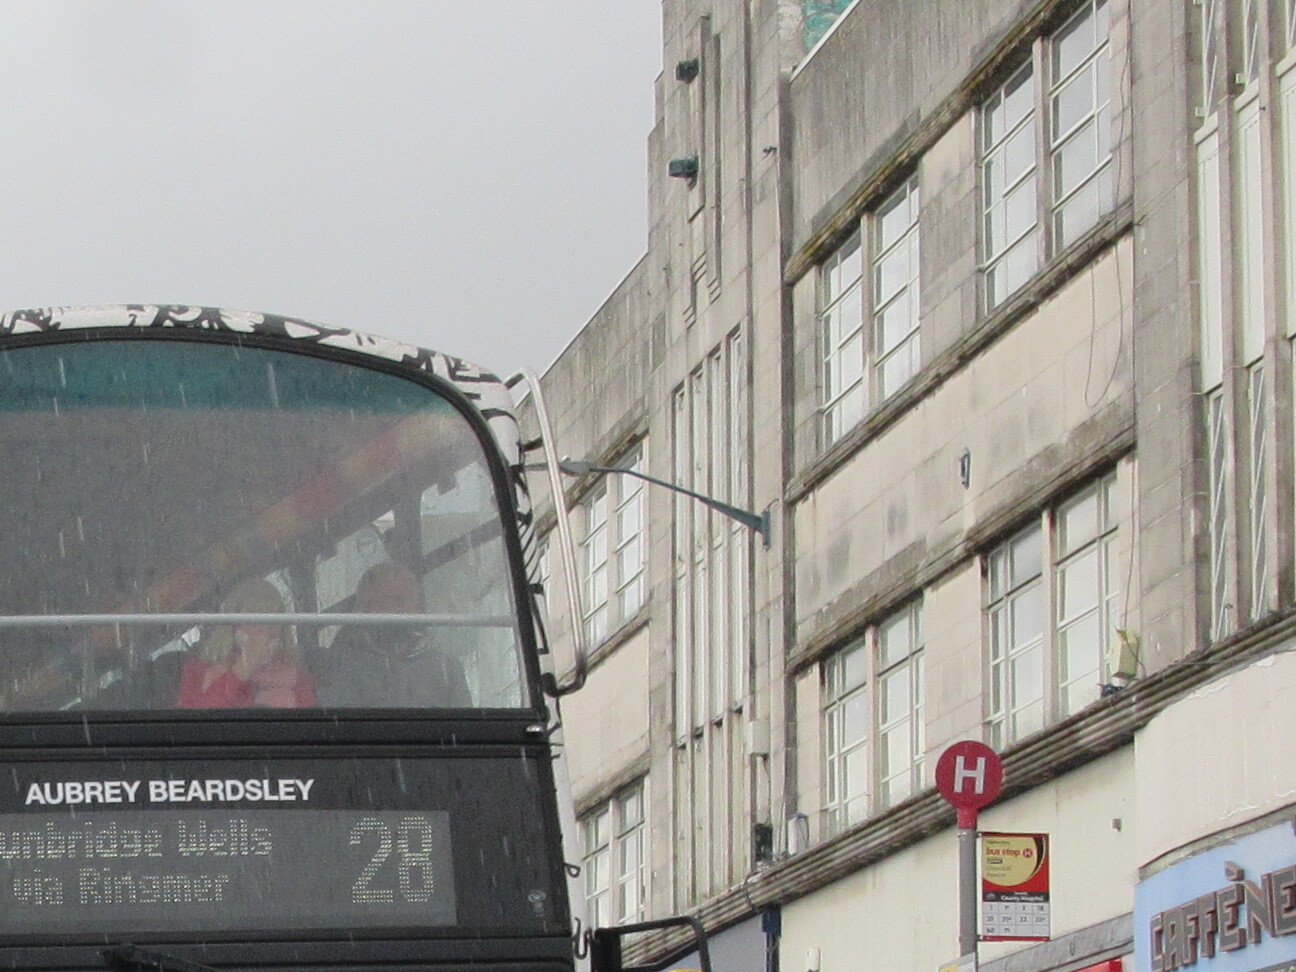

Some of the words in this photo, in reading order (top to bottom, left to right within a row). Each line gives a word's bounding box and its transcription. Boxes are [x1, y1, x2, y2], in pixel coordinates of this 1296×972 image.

[25, 781, 141, 805] AUBREY
[148, 778, 316, 803] BEARDSLEY
[954, 755, 986, 795] H
[177, 818, 273, 857] Wells
[349, 816, 435, 903] 28
[13, 868, 64, 905] via
[79, 867, 230, 905] Ringmer
